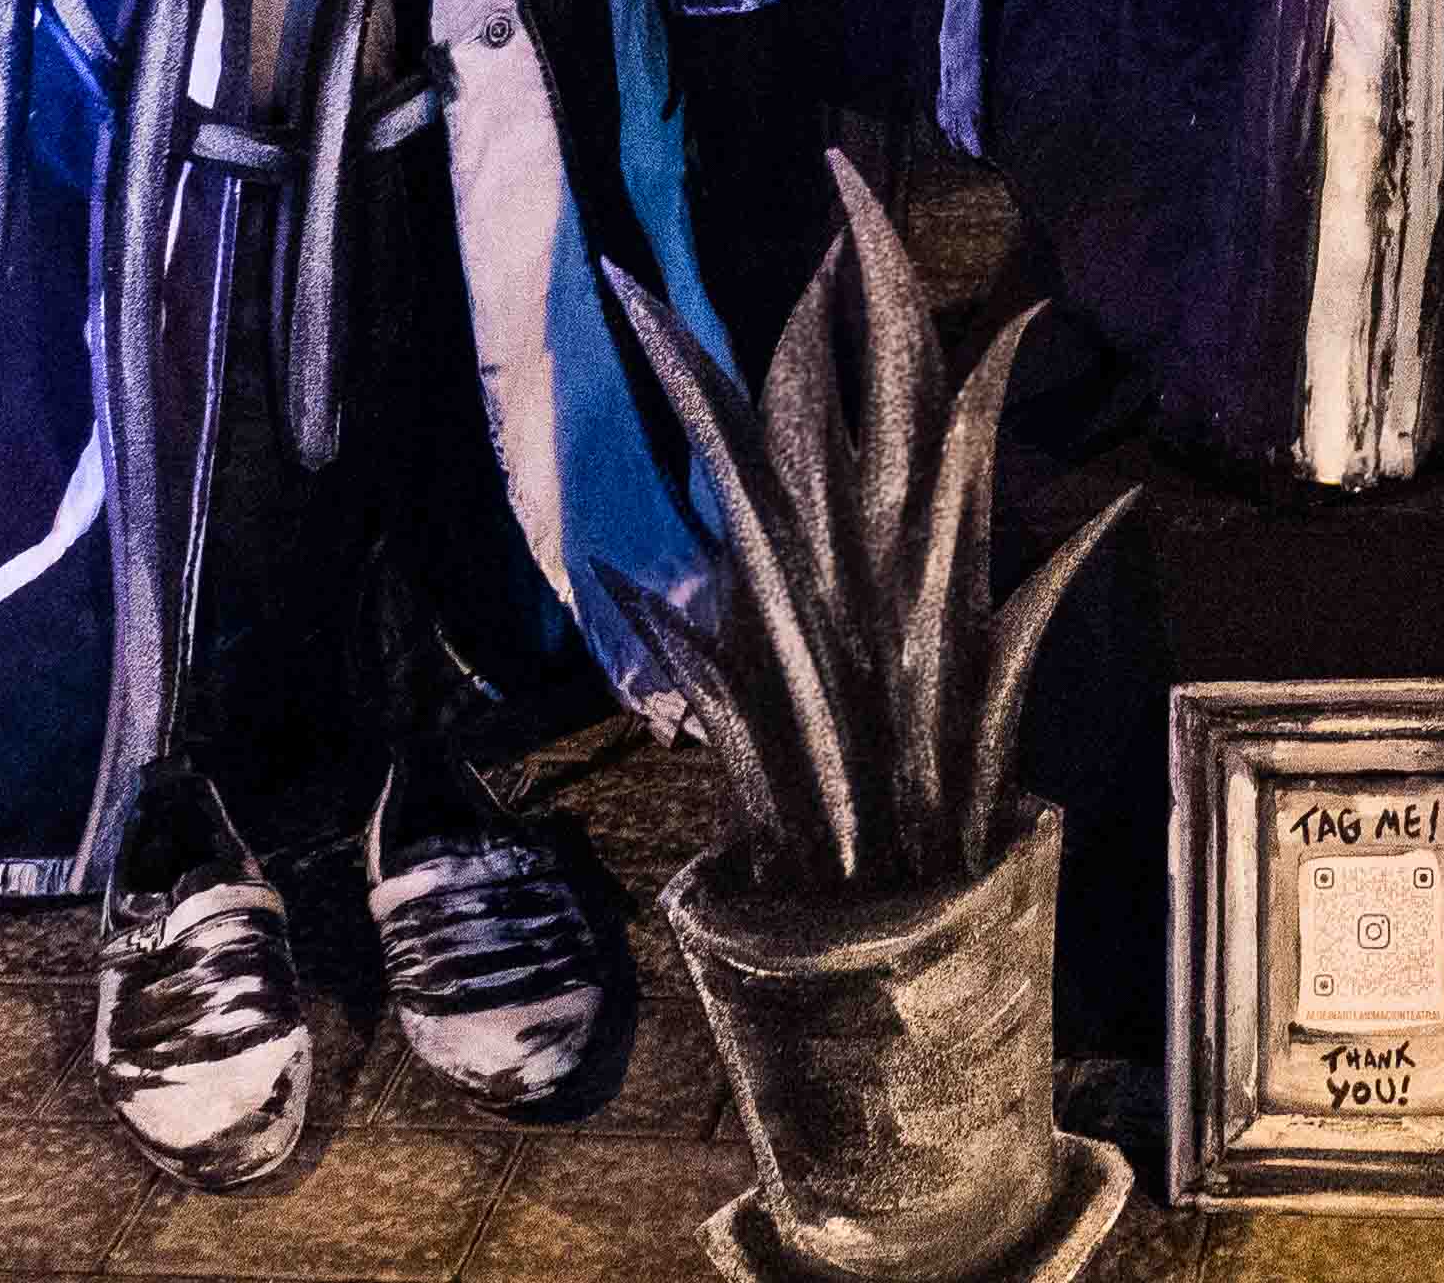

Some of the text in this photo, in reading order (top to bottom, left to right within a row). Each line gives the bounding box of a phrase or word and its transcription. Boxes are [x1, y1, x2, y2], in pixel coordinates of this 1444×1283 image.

[1290, 799, 1440, 845] TAG ME!
[1319, 1040, 1417, 1074] THANK
[1326, 1075, 1411, 1114] YOU!
